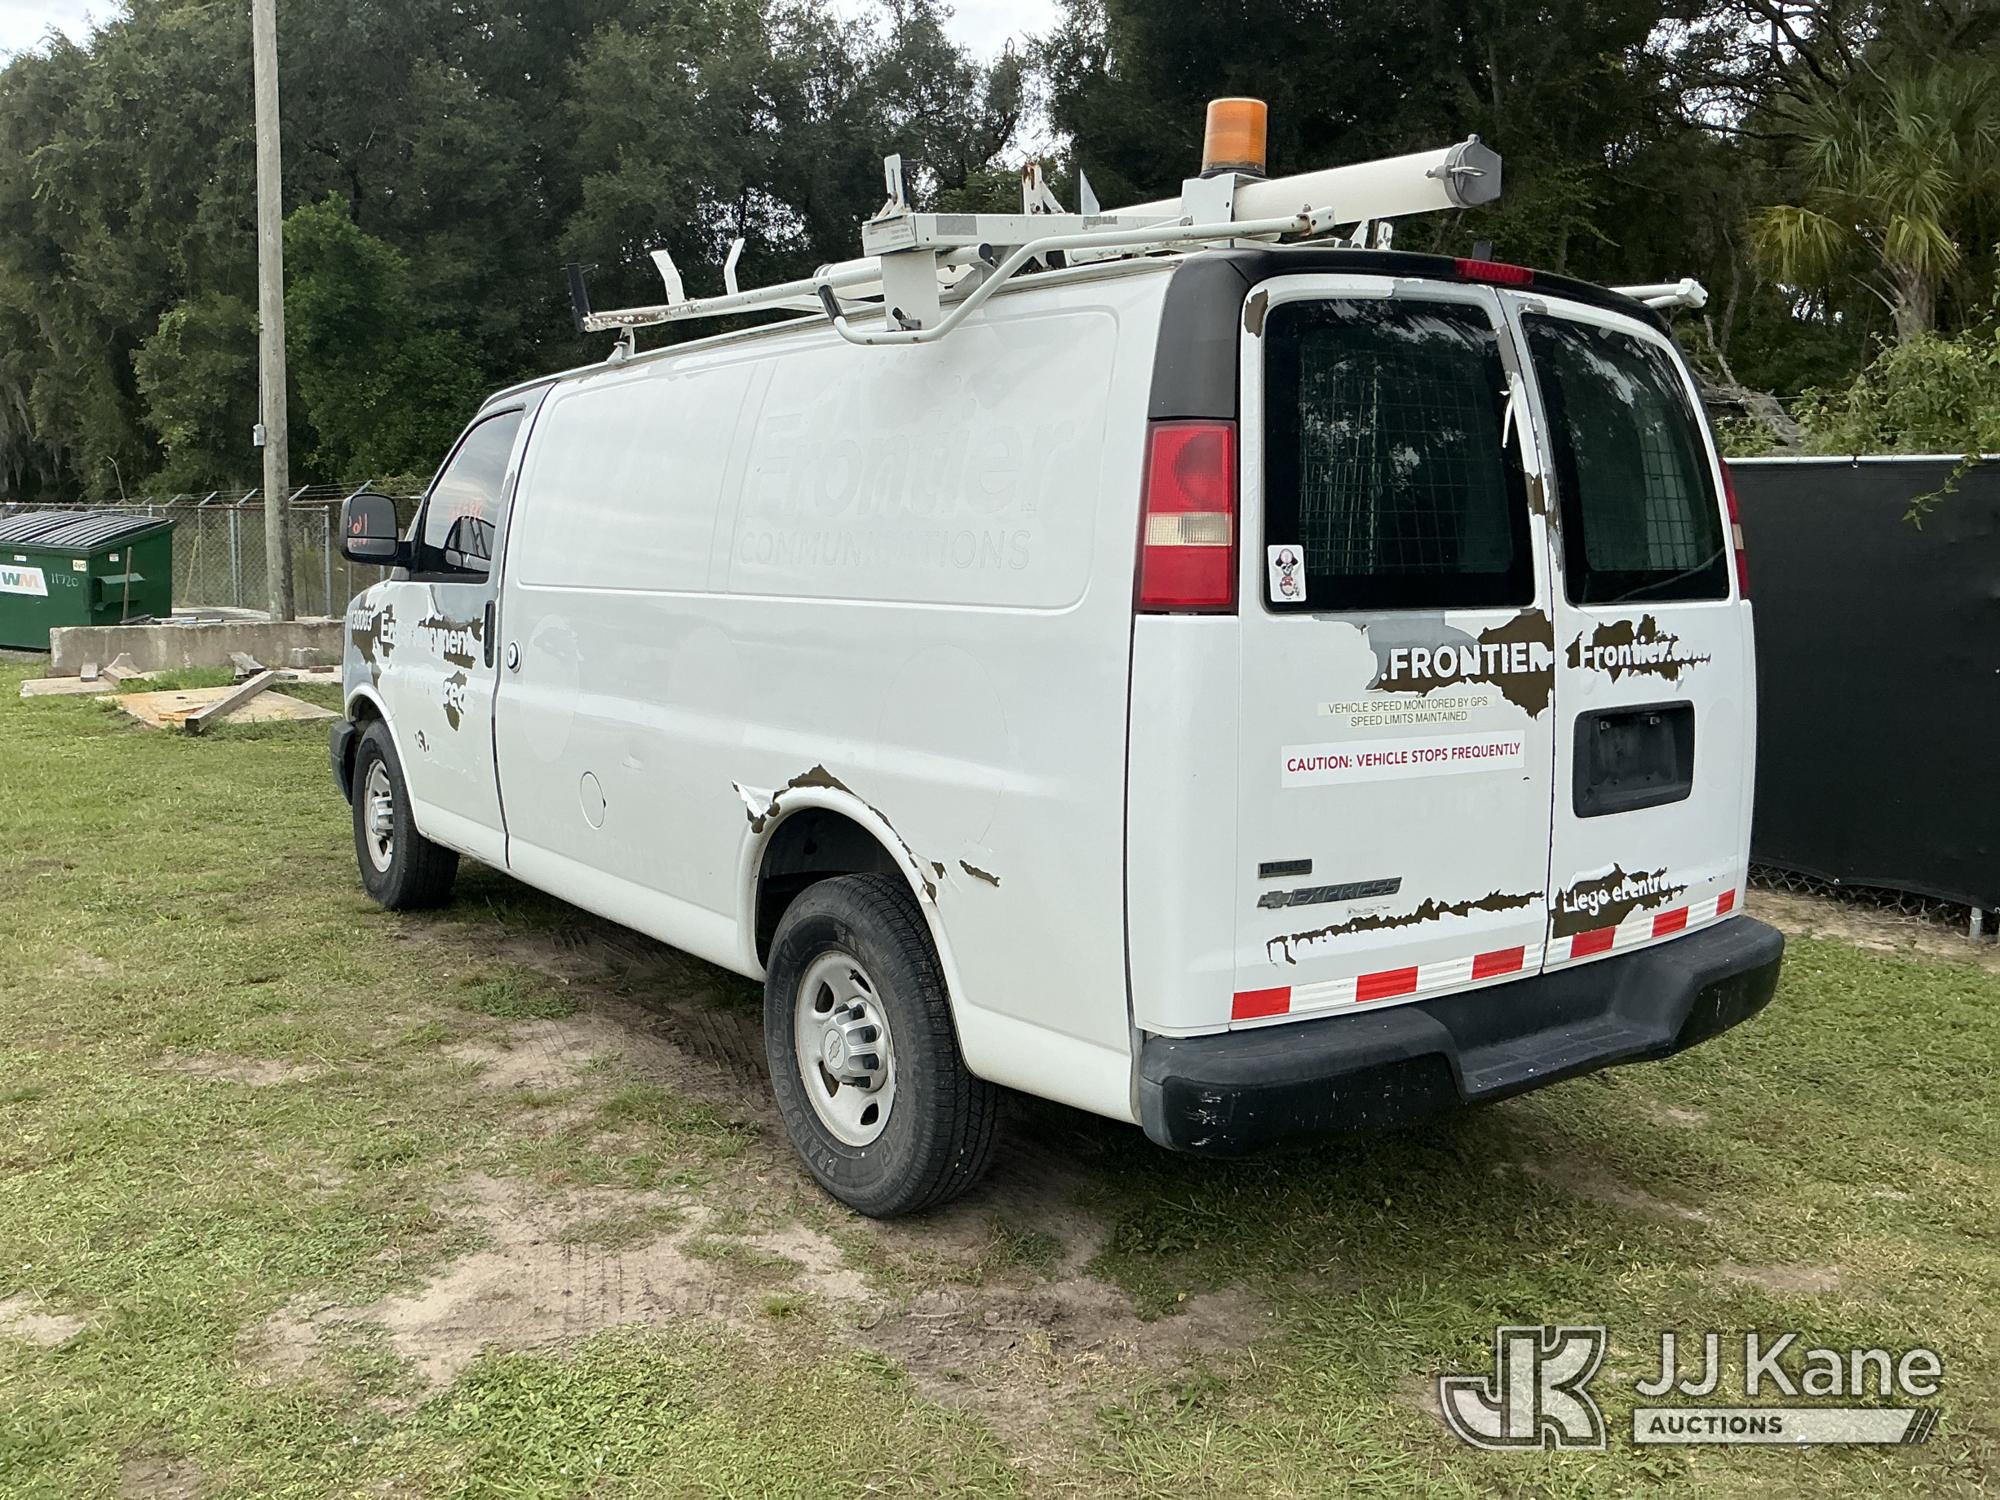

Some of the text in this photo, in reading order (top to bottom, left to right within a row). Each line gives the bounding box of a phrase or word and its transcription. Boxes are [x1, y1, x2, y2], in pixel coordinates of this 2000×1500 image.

[740, 528, 1032, 570] COMMUNTIONS
[2, 572, 40, 588] WM
[1328, 696, 1488, 715] VEHICLE SPEED MONITORED BY GPS
[1350, 711, 1468, 727] SPEED LIMITS MAINTAINED
[1287, 742, 1521, 773] CAUTION: VEHICLE STOPS FREQUENTLY
[1293, 878, 1402, 905] EXPRESS
